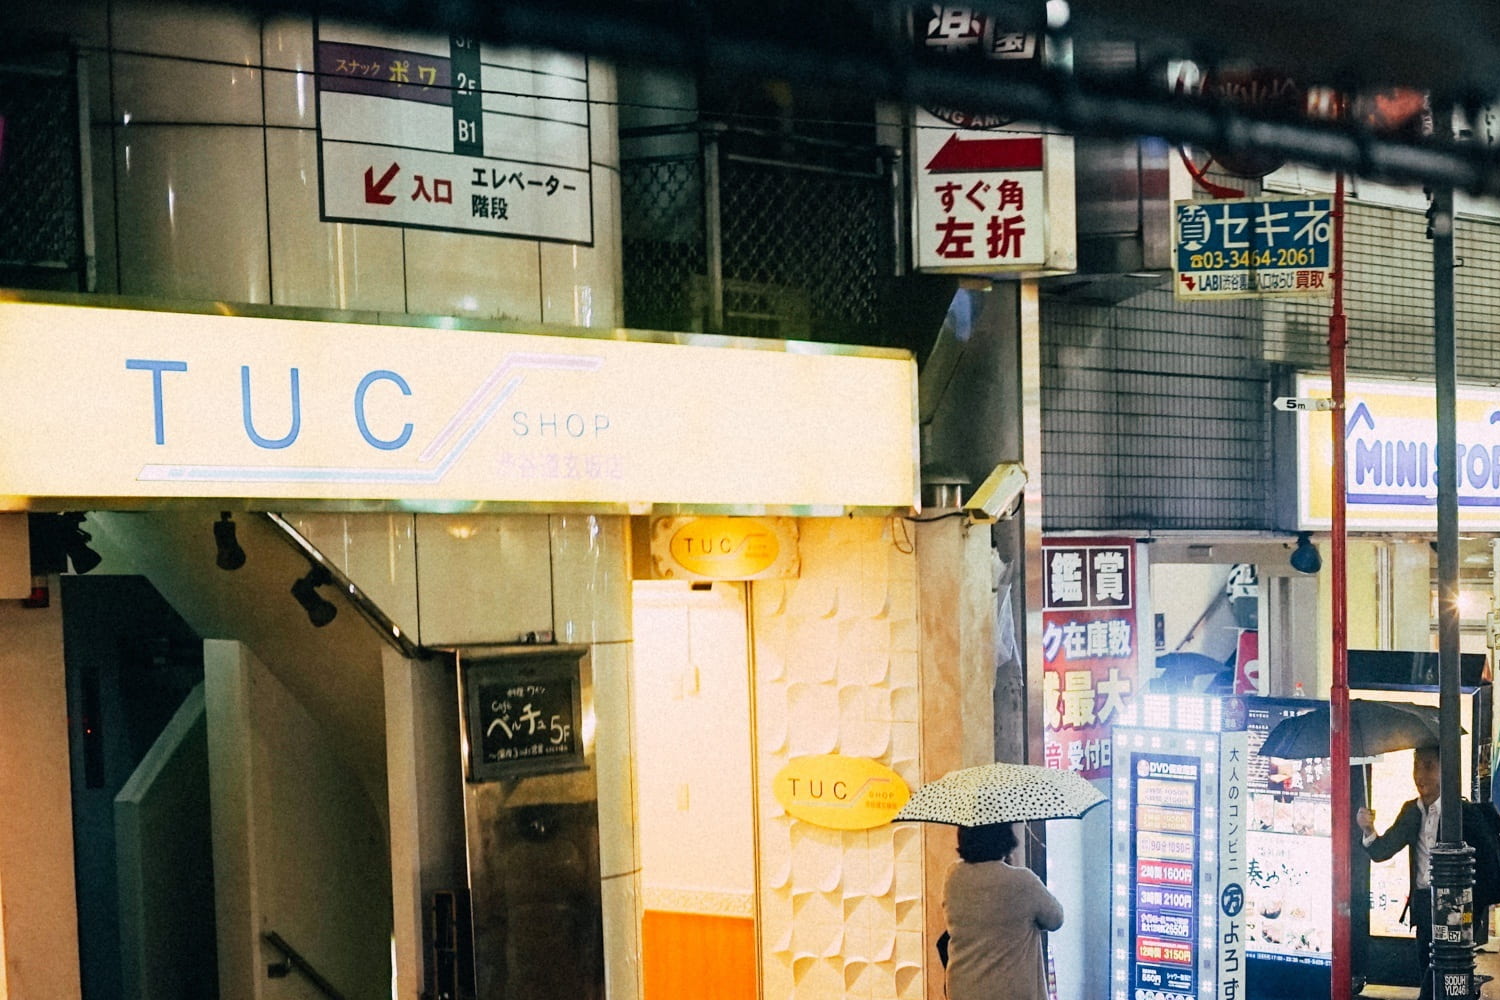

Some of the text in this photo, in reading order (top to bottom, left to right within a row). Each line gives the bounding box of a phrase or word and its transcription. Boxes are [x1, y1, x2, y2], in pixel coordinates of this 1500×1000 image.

[335, 58, 380, 76] スナック
[457, 73, 476, 97] 2F
[458, 119, 477, 143] B1
[411, 175, 453, 204] 入口
[471, 168, 577, 197] エレベーター
[471, 195, 508, 221] 階段
[935, 179, 1024, 214] すぐ角
[935, 215, 1026, 259] 左折
[1203, 248, 1316, 269] 03-3464-2061
[1296, 270, 1325, 290] 買取
[126, 359, 414, 451] TUC
[1286, 399, 1306, 410] 5m
[512, 410, 610, 439] SHOP
[684, 537, 731, 554] TUC
[1049, 552, 1126, 602] 鑑賞
[550, 715, 571, 745] 5F
[788, 777, 848, 801] TUC
[1228, 748, 1240, 871] 大人のコンビニ
[1163, 892, 1192, 908] 2100円
[1164, 947, 1191, 962] 3150円
